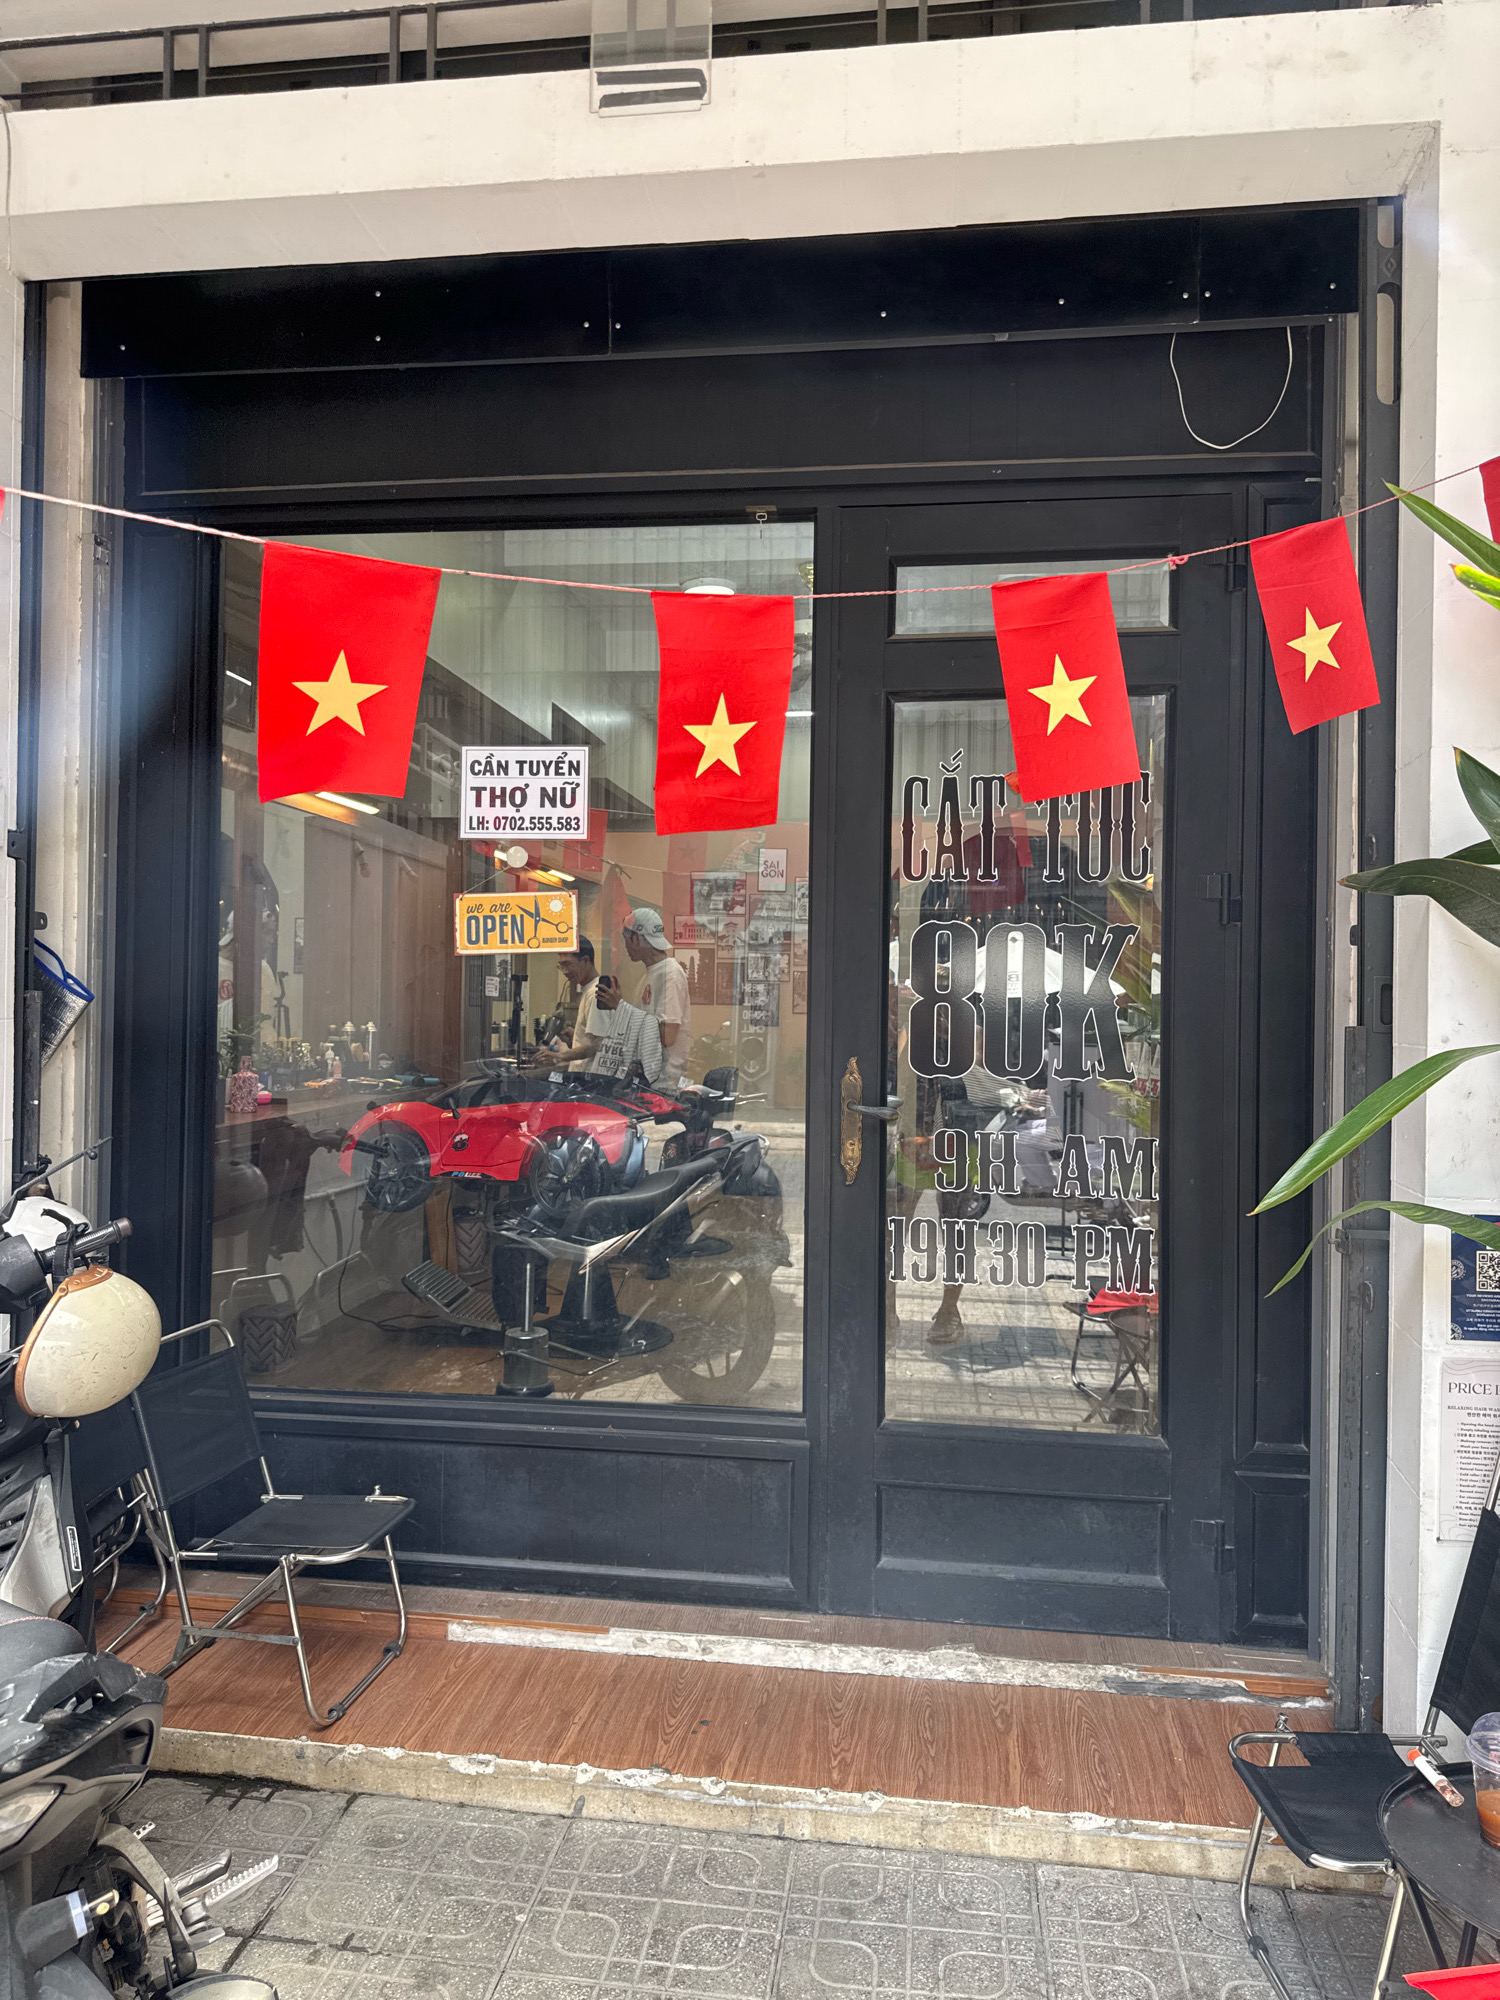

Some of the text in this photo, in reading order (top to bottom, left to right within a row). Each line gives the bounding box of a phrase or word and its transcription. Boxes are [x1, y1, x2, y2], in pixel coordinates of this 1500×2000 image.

[469, 751, 580, 776] CẦN TUYỂN
[470, 781, 581, 813] THỢ NỮ
[469, 816, 580, 831] LH: 0702.555.583
[901, 748, 1009, 882] CẮT
[761, 869, 784, 878] GON
[763, 860, 779, 869] SAI
[466, 902, 512, 914] we are
[466, 913, 525, 946] OPEN
[908, 919, 1141, 1083] 80K
[933, 1128, 1159, 1201] 9H AM
[1071, 1224, 1156, 1297] PM
[1448, 1382, 1492, 1396] PRICE
